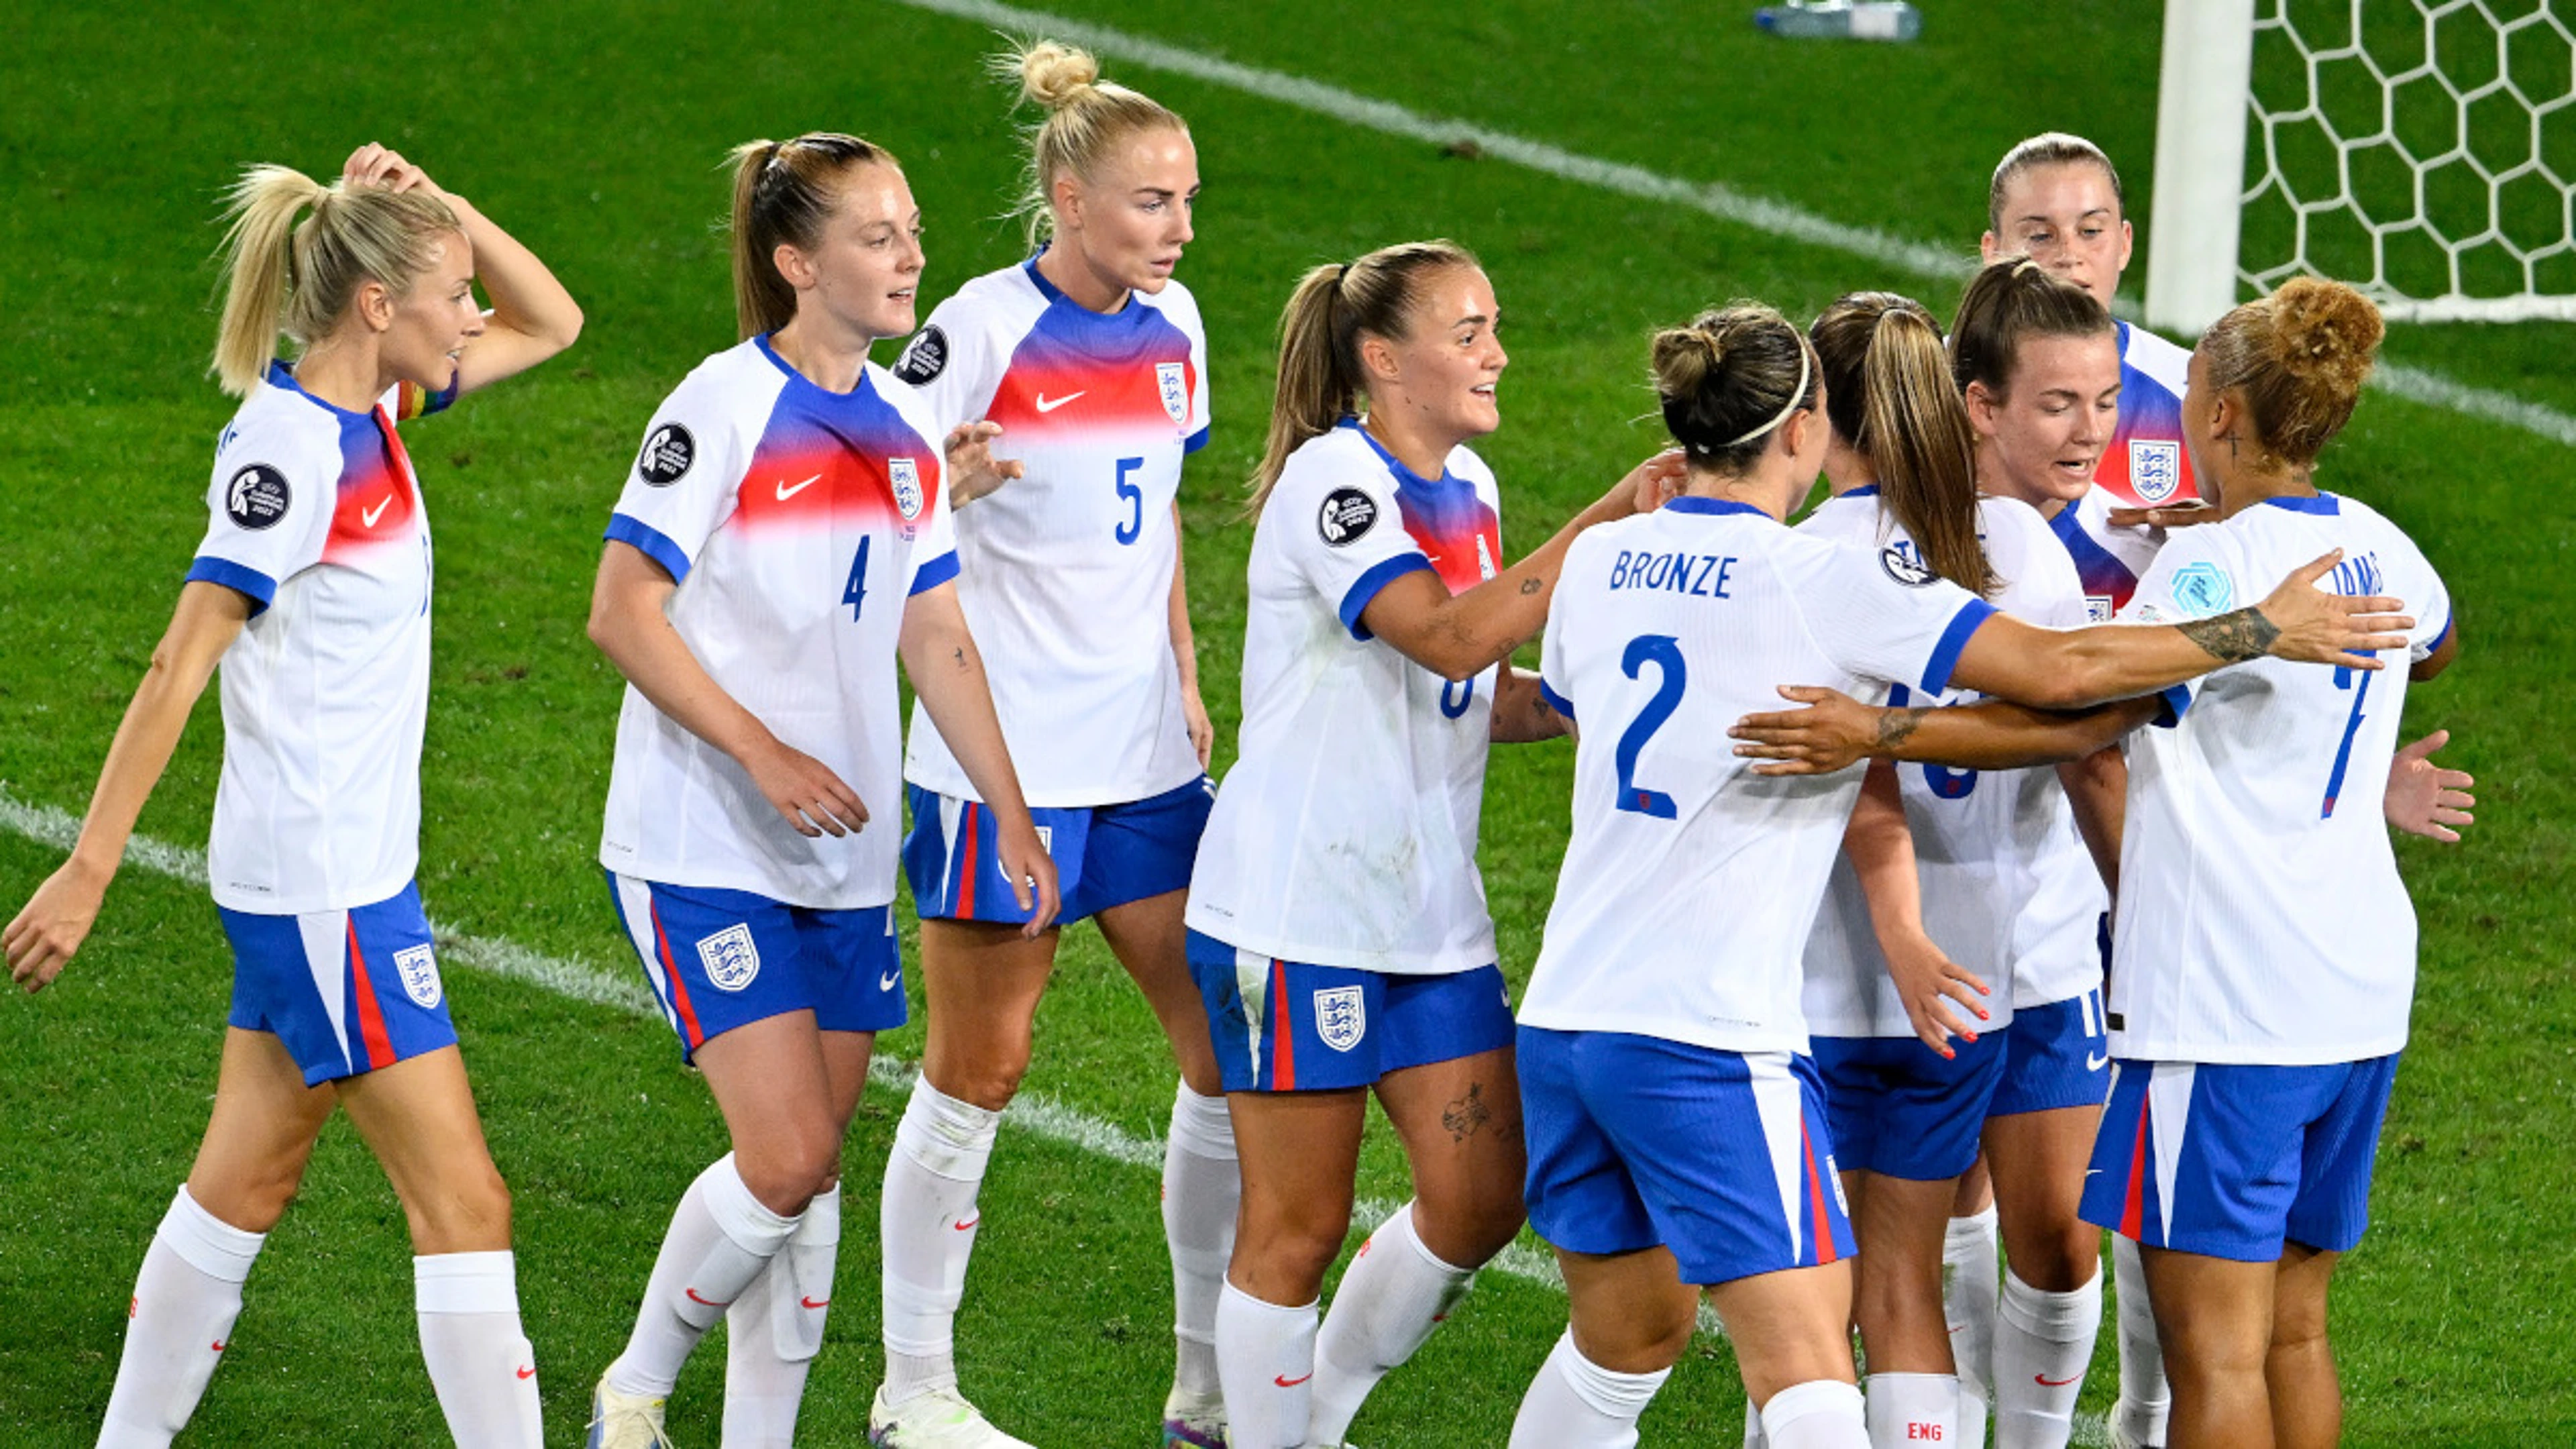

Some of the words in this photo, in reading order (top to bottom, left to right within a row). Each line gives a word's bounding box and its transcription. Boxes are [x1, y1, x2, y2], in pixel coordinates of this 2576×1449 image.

[1115, 457, 1144, 546] 5
[841, 535, 871, 623] 4
[1609, 549, 1738, 600] BRONZE
[1615, 634, 1687, 820] 2
[2320, 647, 2377, 820] 7
[1907, 1422, 1942, 1442] ENG
